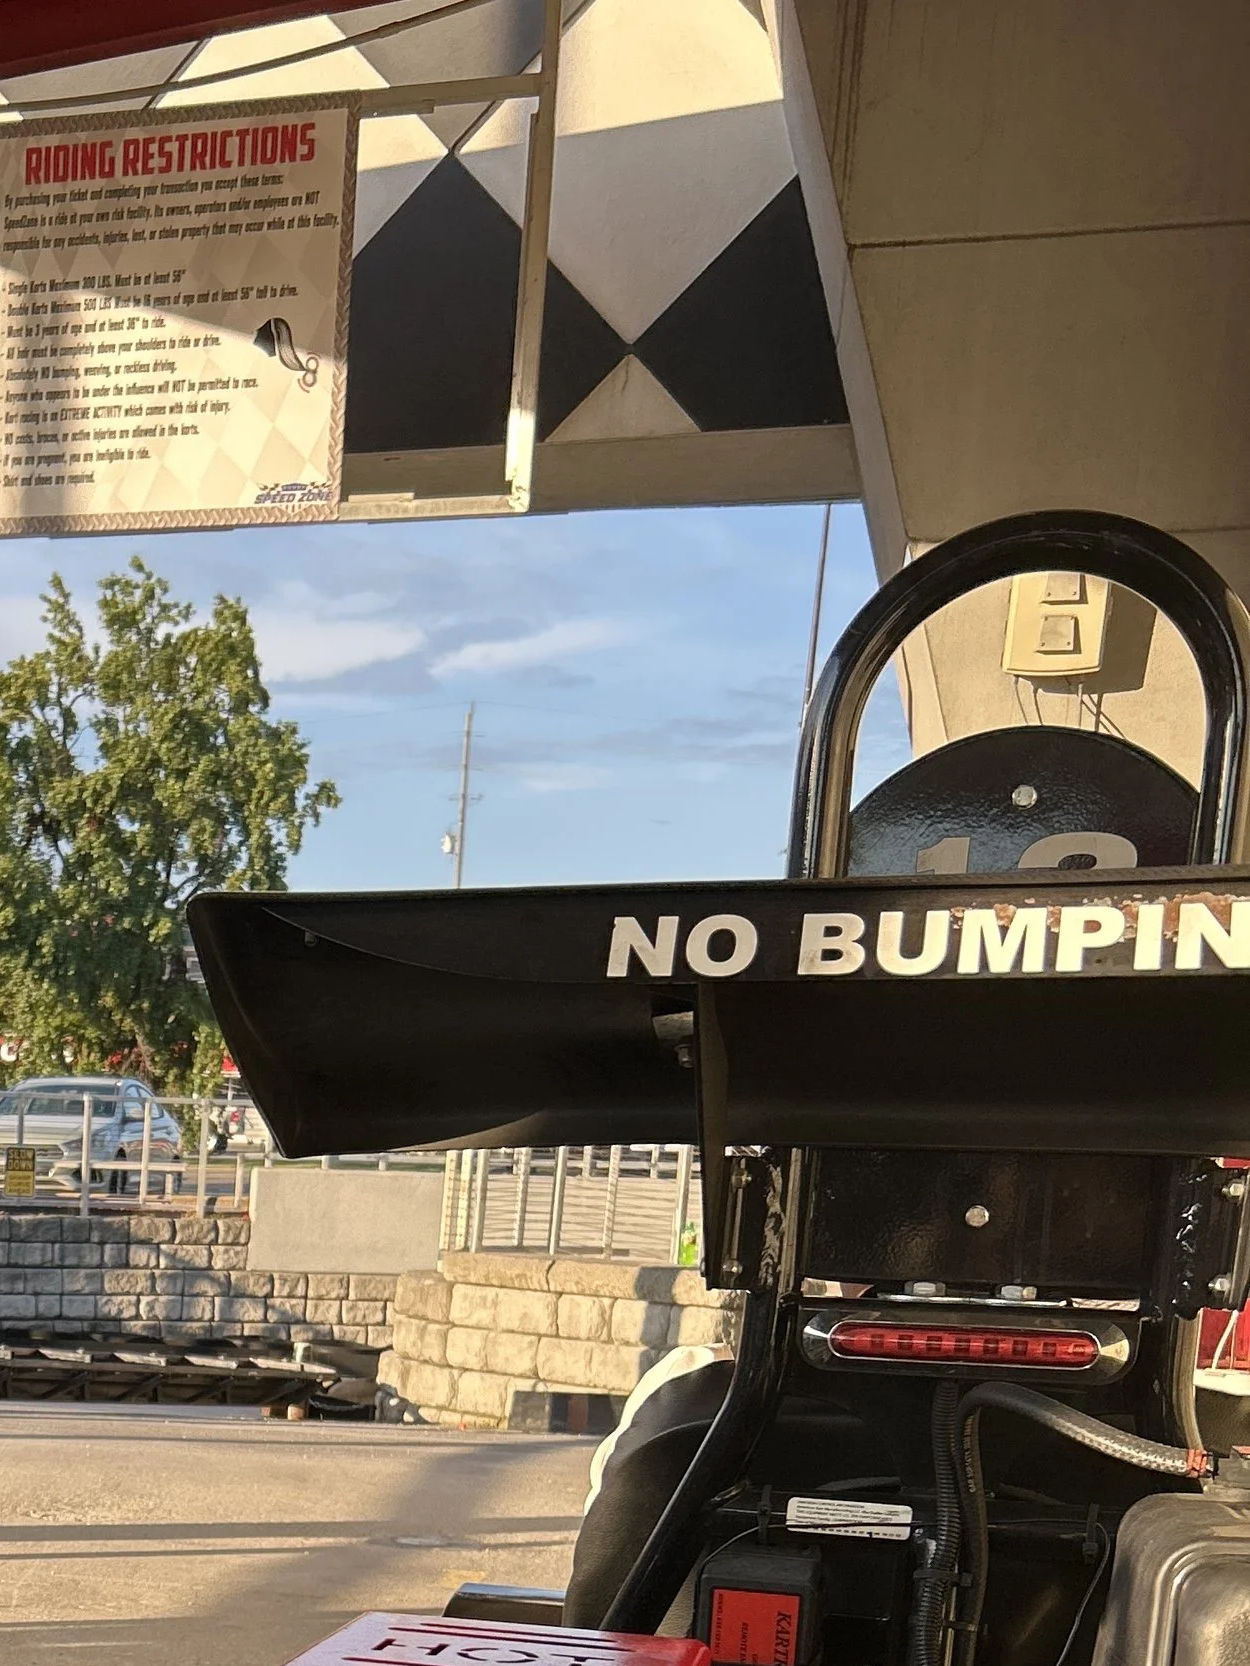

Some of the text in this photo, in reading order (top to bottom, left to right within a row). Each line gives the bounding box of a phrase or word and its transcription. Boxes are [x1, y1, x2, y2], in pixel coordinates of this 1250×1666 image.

[25, 122, 316, 185] RIDING RESTRICTIONS
[4, 194, 12, 210] By
[14, 191, 50, 209] purchasing
[52, 193, 66, 205] your
[69, 187, 88, 201] ticket
[90, 186, 102, 200] and
[104, 183, 141, 201] completing
[143, 185, 157, 199] your
[160, 179, 198, 194] transaction
[200, 181, 212, 193] you
[214, 176, 237, 192] accept
[240, 173, 259, 187] these
[54, 211, 67, 225] ride
[69, 212, 77, 224] at
[79, 213, 93, 226] your
[95, 211, 109, 221] own
[111, 207, 124, 220] risk
[126, 205, 152, 222] facility.
[165, 204, 192, 217] owners,
[194, 200, 226, 216] operators
[228, 196, 250, 211] and/or
[253, 193, 289, 211] employees
[290, 196, 302, 205] are
[304, 190, 319, 204] NOT
[3, 236, 39, 254] responsible
[41, 235, 51, 248] for
[53, 237, 65, 249] any
[67, 231, 101, 247] accidents,
[148, 230, 156, 240] or
[158, 224, 179, 239] stolen
[181, 223, 209, 240] property
[211, 221, 226, 234] that
[228, 223, 242, 236] may
[244, 221, 264, 232] occur
[266, 216, 285, 230] while
[287, 217, 294, 228] at
[297, 214, 310, 227] this
[312, 212, 339, 229] facility.
[8, 281, 27, 297] Single
[29, 279, 46, 293] Karts
[48, 277, 79, 291] Maximum
[82, 276, 95, 289] 300
[97, 275, 111, 288] LBS.
[114, 273, 131, 286] Must
[133, 272, 141, 285] be
[143, 273, 150, 284] at
[153, 270, 170, 283] least
[8, 302, 29, 316] Double
[31, 301, 48, 314] Karts
[50, 299, 80, 313] Maximum
[83, 298, 96, 311] 500
[114, 295, 130, 308] Must
[153, 295, 171, 308] years
[172, 292, 180, 304] of
[182, 294, 194, 306] age
[196, 289, 209, 302] and
[211, 290, 218, 302] at
[221, 287, 238, 301] least
[255, 285, 267, 298] tall
[269, 285, 277, 297] to
[279, 283, 297, 297] drive.
[7, 315, 166, 339] Must be 3 years of age and at least ride.
[31, 333, 221, 359] must be completely above your shoulders to ride or drive.
[6, 366, 38, 383] Absolutely
[40, 366, 49, 378] NO
[114, 365, 121, 374] or
[123, 360, 150, 373] reckless
[152, 358, 177, 374] driving.
[5, 376, 258, 405] Anyone who appears to be under the influence will NOT be permitted to race.
[5, 399, 230, 426] Kart racing EXTREME ACTIVITY which comes with risk of injury.
[4, 422, 199, 444] NO active injuries are allowed the karts.
[11, 456, 22, 468] you
[24, 456, 35, 465] are
[69, 453, 80, 465] you
[82, 452, 93, 462] are
[137, 447, 150, 458] ride.
[3, 472, 64, 487] Shirt and shoes are
[254, 489, 333, 504] SPEED ZONE
[606, 903, 1250, 978] NO BUMPIN
[7, 1160, 33, 1170] DOWN
